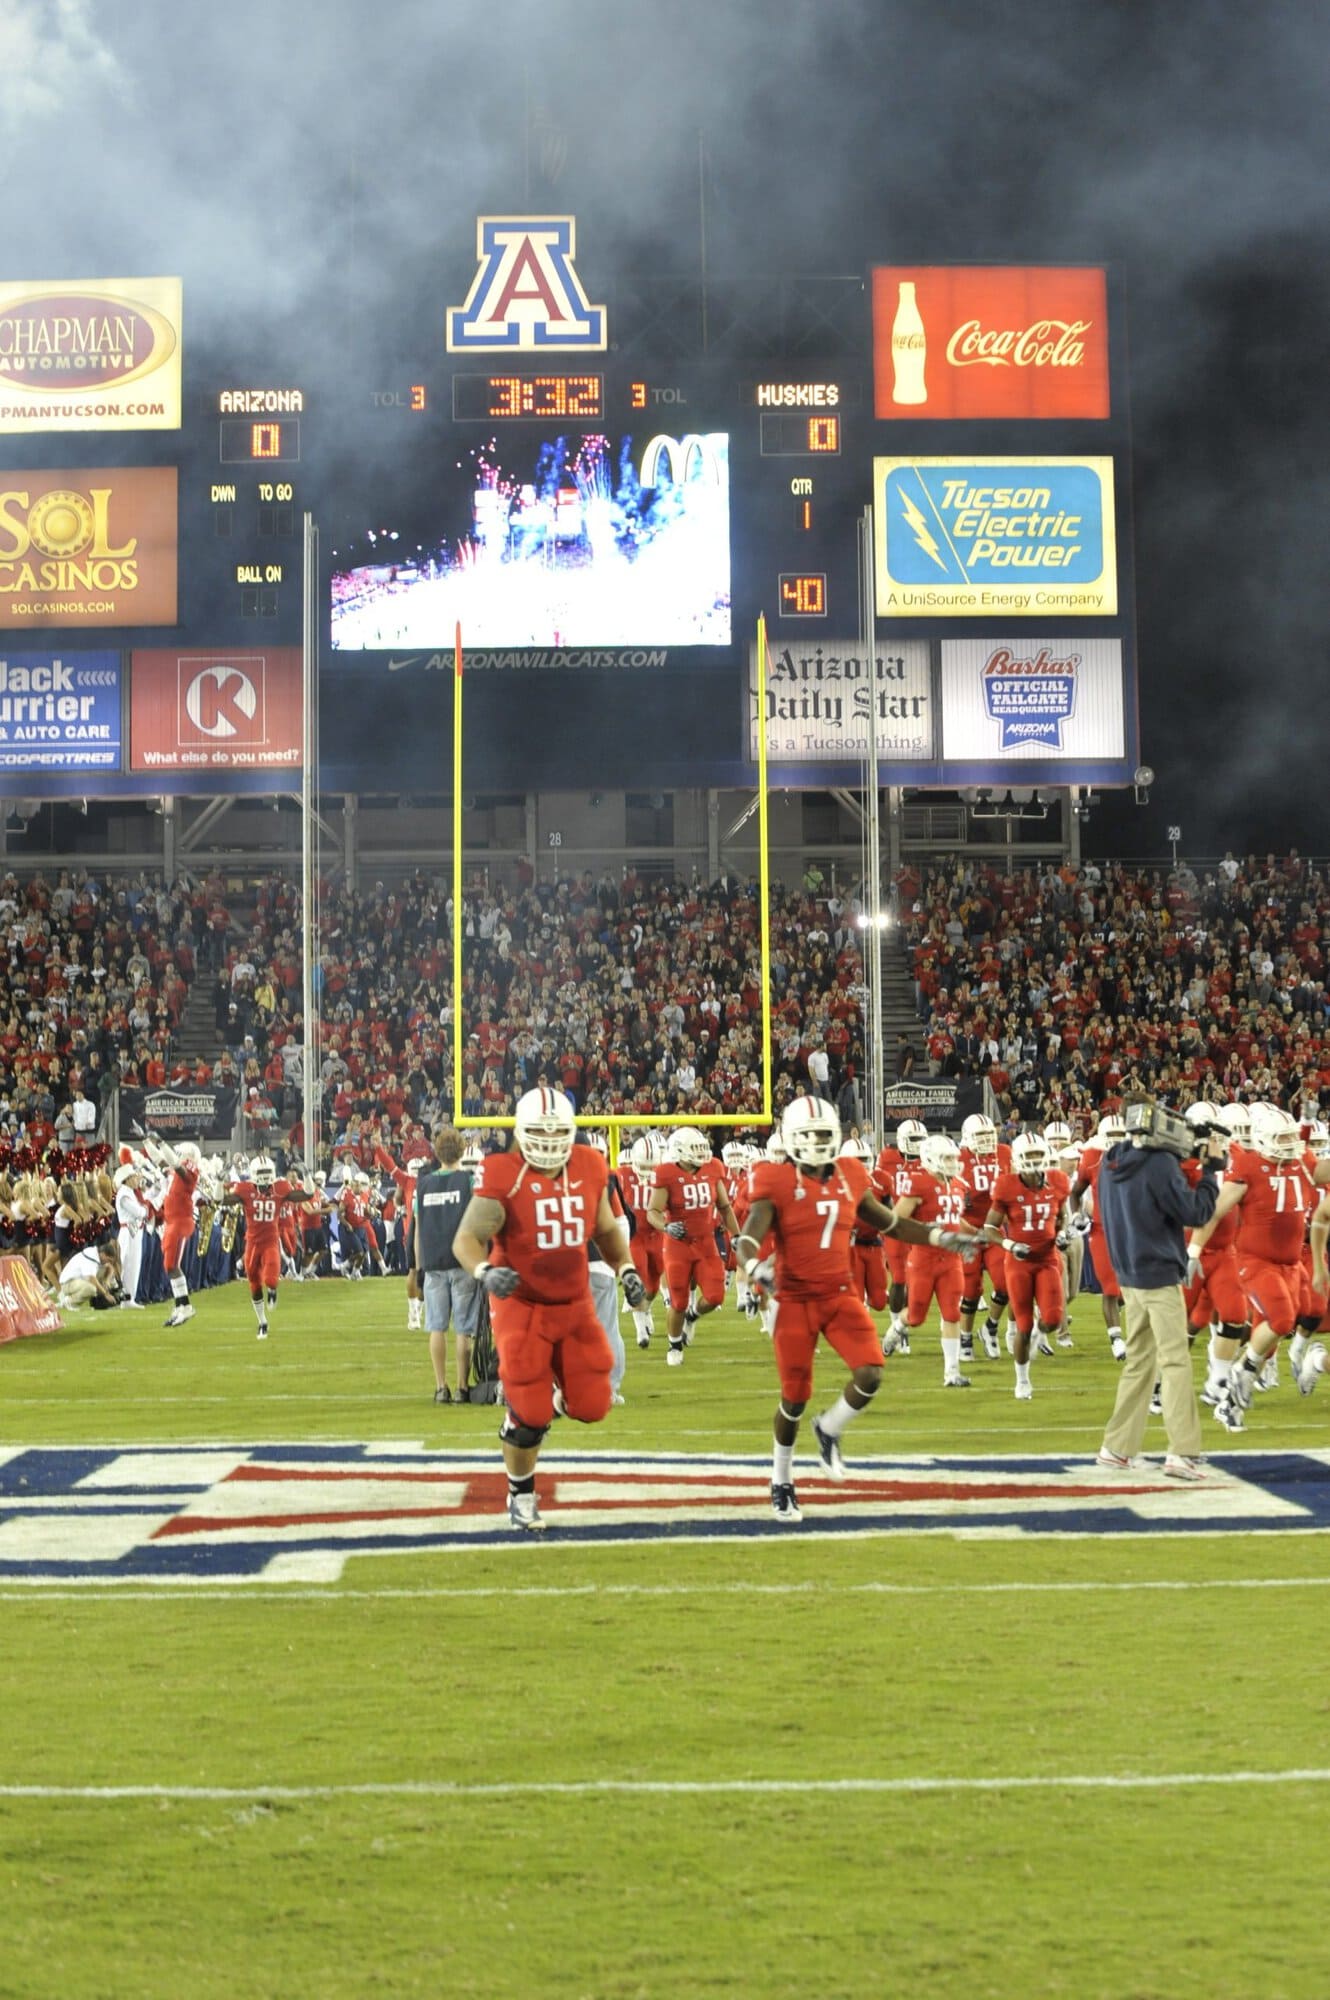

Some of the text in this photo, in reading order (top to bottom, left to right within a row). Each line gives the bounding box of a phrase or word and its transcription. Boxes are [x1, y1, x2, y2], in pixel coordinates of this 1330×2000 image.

[446, 215, 607, 352] A
[0, 315, 136, 355] CHAPMAN
[946, 320, 1092, 367] Coca-Cola
[0, 355, 134, 371] AUTOMOTIVE
[220, 391, 303, 412] ARIZONA
[370, 391, 406, 406] TOL
[411, 386, 425, 409] 3
[490, 377, 599, 415] 3:32
[632, 383, 645, 408] 3
[652, 389, 687, 404] TOL
[758, 384, 839, 406] HUSKIES
[1, 403, 165, 418] PMANTUCSON.COM
[252, 424, 279, 457] 0
[809, 418, 837, 450] 0
[211, 485, 236, 502] DWN
[259, 485, 293, 501] TO GO
[791, 479, 813, 495] QTR
[941, 480, 1051, 509] Tucson
[953, 510, 1082, 537] Electric
[966, 539, 1082, 567] Power
[0, 560, 138, 592] CASINOS
[237, 566, 281, 583] BALL ON
[784, 579, 823, 611] 40
[887, 592, 1104, 608] A UniSource Energy Company
[11, 602, 115, 614] SOLCASINOS.COM
[425, 651, 667, 671] ARZONAWILDCATS.COM
[991, 681, 1068, 692] OFFICIAL
[193, 666, 256, 738] K
[750, 686, 928, 727] Daily Star
[991, 694, 1068, 705] TAILGATE
[991, 706, 1068, 715] HEADQUARTERS
[14, 726, 60, 740] AUTO
[65, 725, 110, 740] CARE
[1006, 723, 1055, 733] ARIZONA
[753, 734, 779, 750] I's
[785, 738, 796, 750] a
[803, 734, 867, 750] Tucson
[144, 749, 299, 766] What else do you need?
[549, 832, 562, 846] 28
[1168, 827, 1181, 841] 29
[886, 1090, 956, 1098] AMERICAN FAMILY
[1023, 1080, 1037, 1092] 32
[422, 1189, 461, 1207] ESPN
[683, 1182, 711, 1210] 98
[1269, 1175, 1305, 1213] 71
[252, 1200, 276, 1222] 39
[936, 1195, 964, 1224] 33
[1021, 1203, 1052, 1231] 17
[536, 1195, 585, 1250] 55
[815, 1200, 840, 1249] 7
